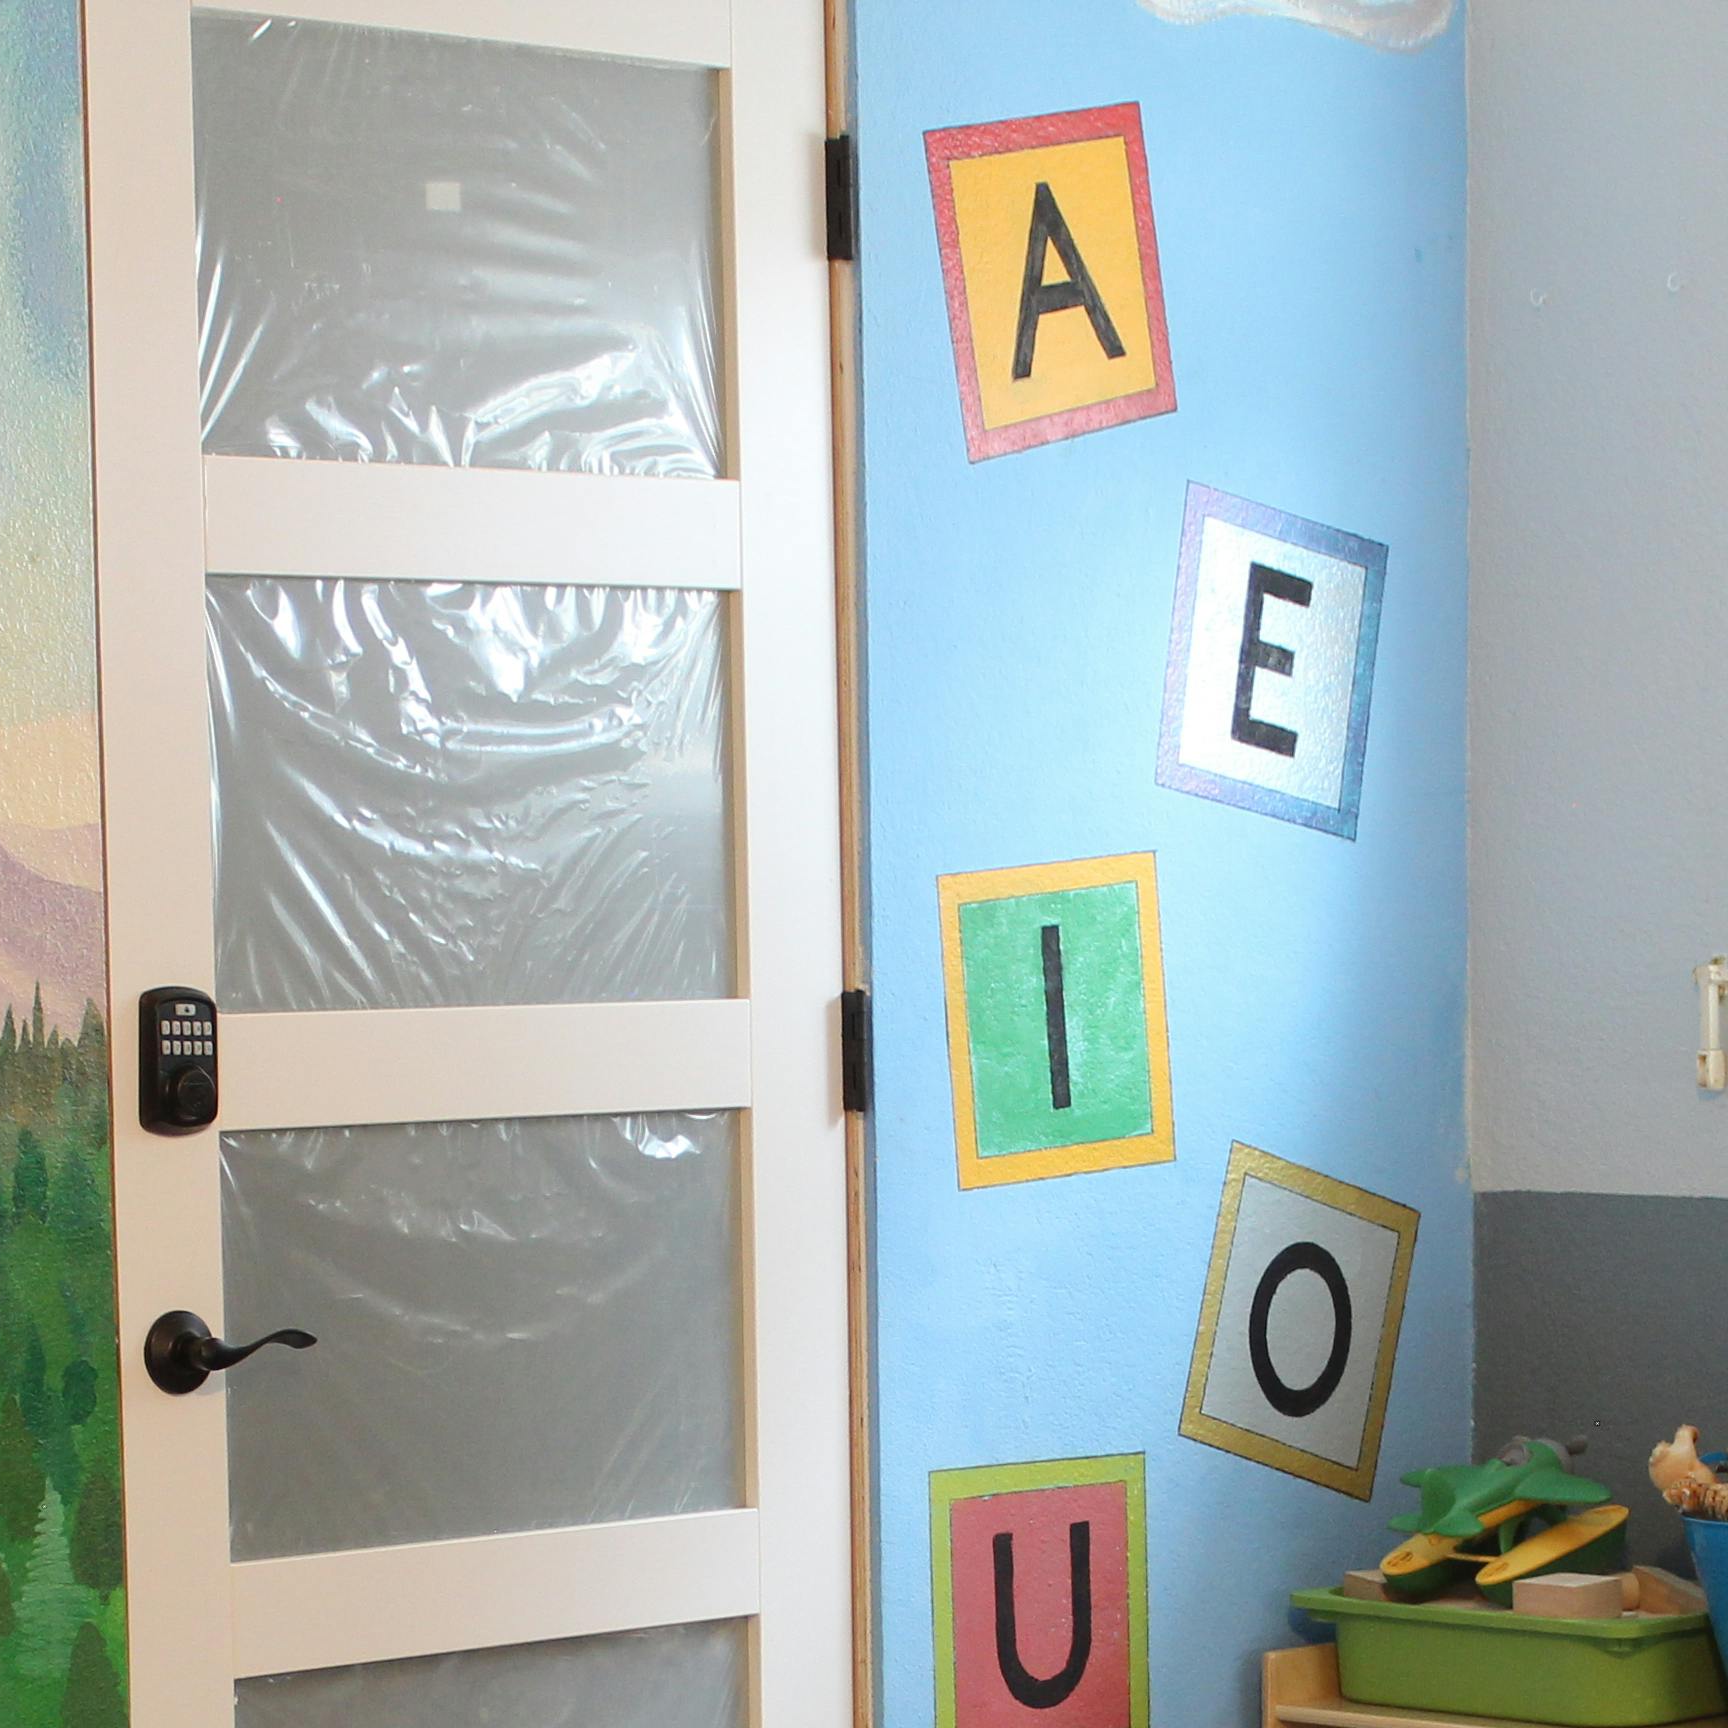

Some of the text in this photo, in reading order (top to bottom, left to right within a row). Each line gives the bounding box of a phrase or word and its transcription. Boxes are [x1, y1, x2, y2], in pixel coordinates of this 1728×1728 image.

[1011, 181, 1125, 380] A
[1230, 560, 1313, 758] E
[1041, 924, 1071, 1110] I
[1249, 1241, 1352, 1417] O
[992, 1520, 1091, 1709] U
